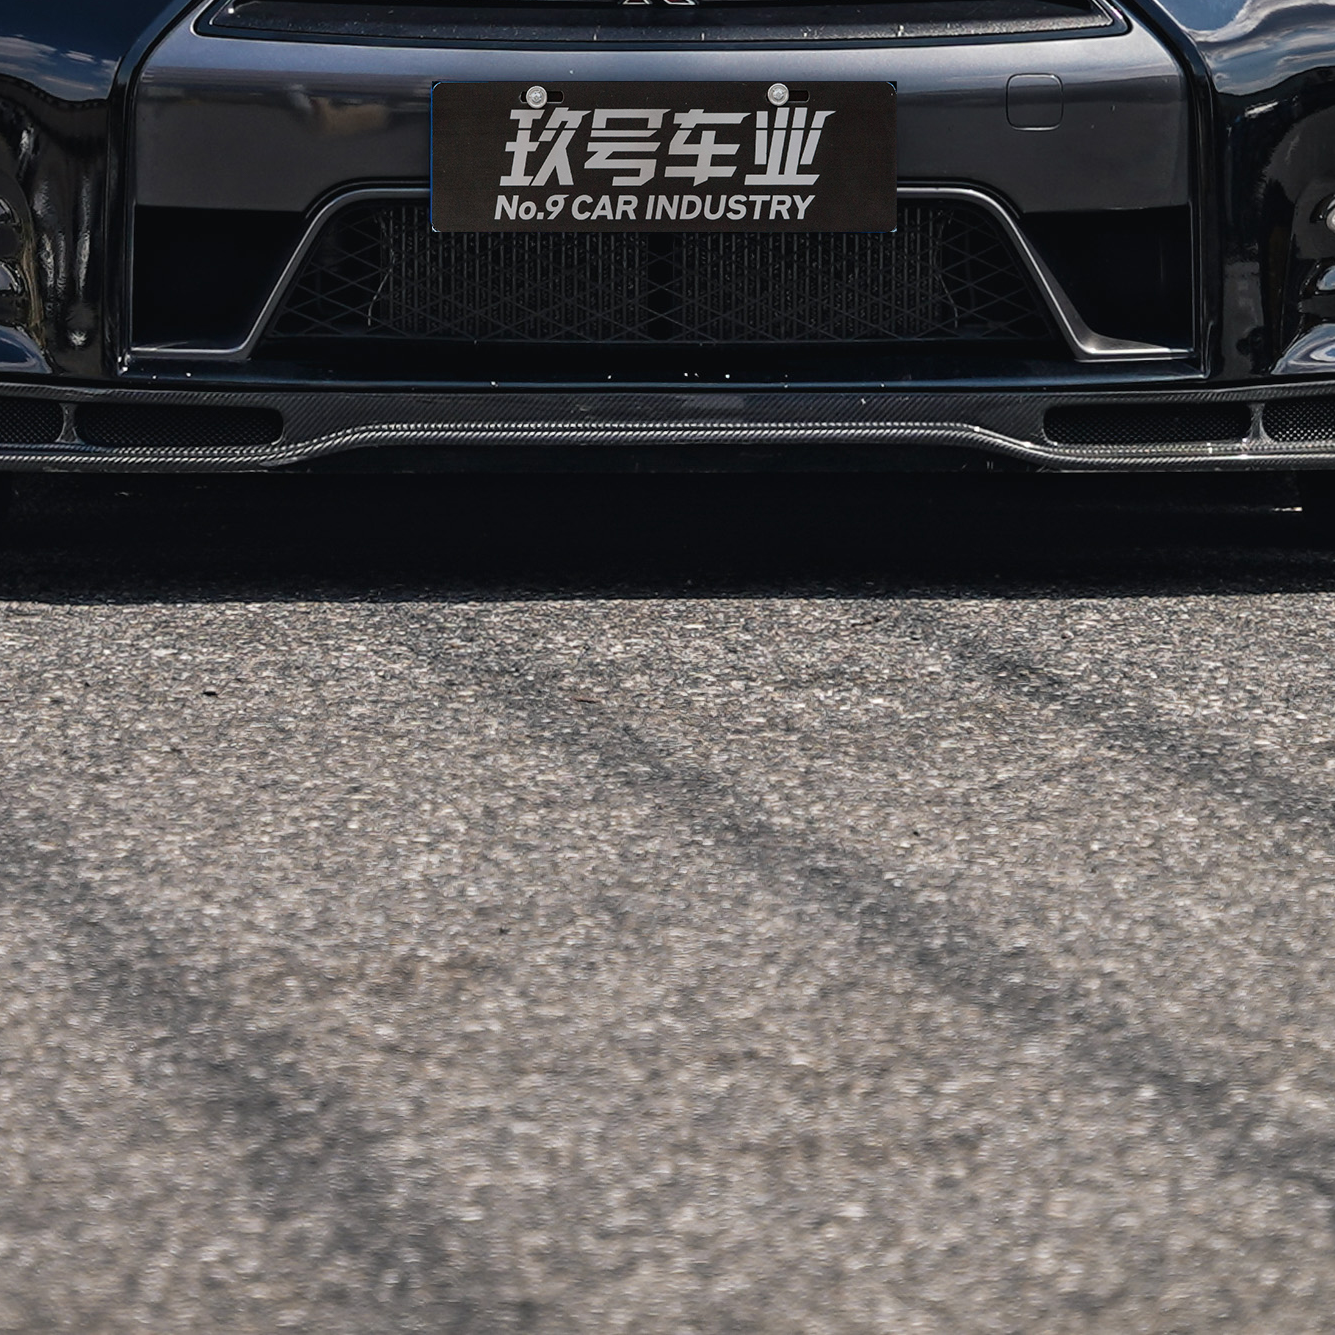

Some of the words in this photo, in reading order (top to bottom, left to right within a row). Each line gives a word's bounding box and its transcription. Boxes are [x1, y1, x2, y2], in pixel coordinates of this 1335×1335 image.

[499, 106, 836, 187] 玖号车业
[494, 194, 570, 221] No.9
[571, 194, 639, 221] CAR
[645, 194, 816, 221] INDUSTRY
